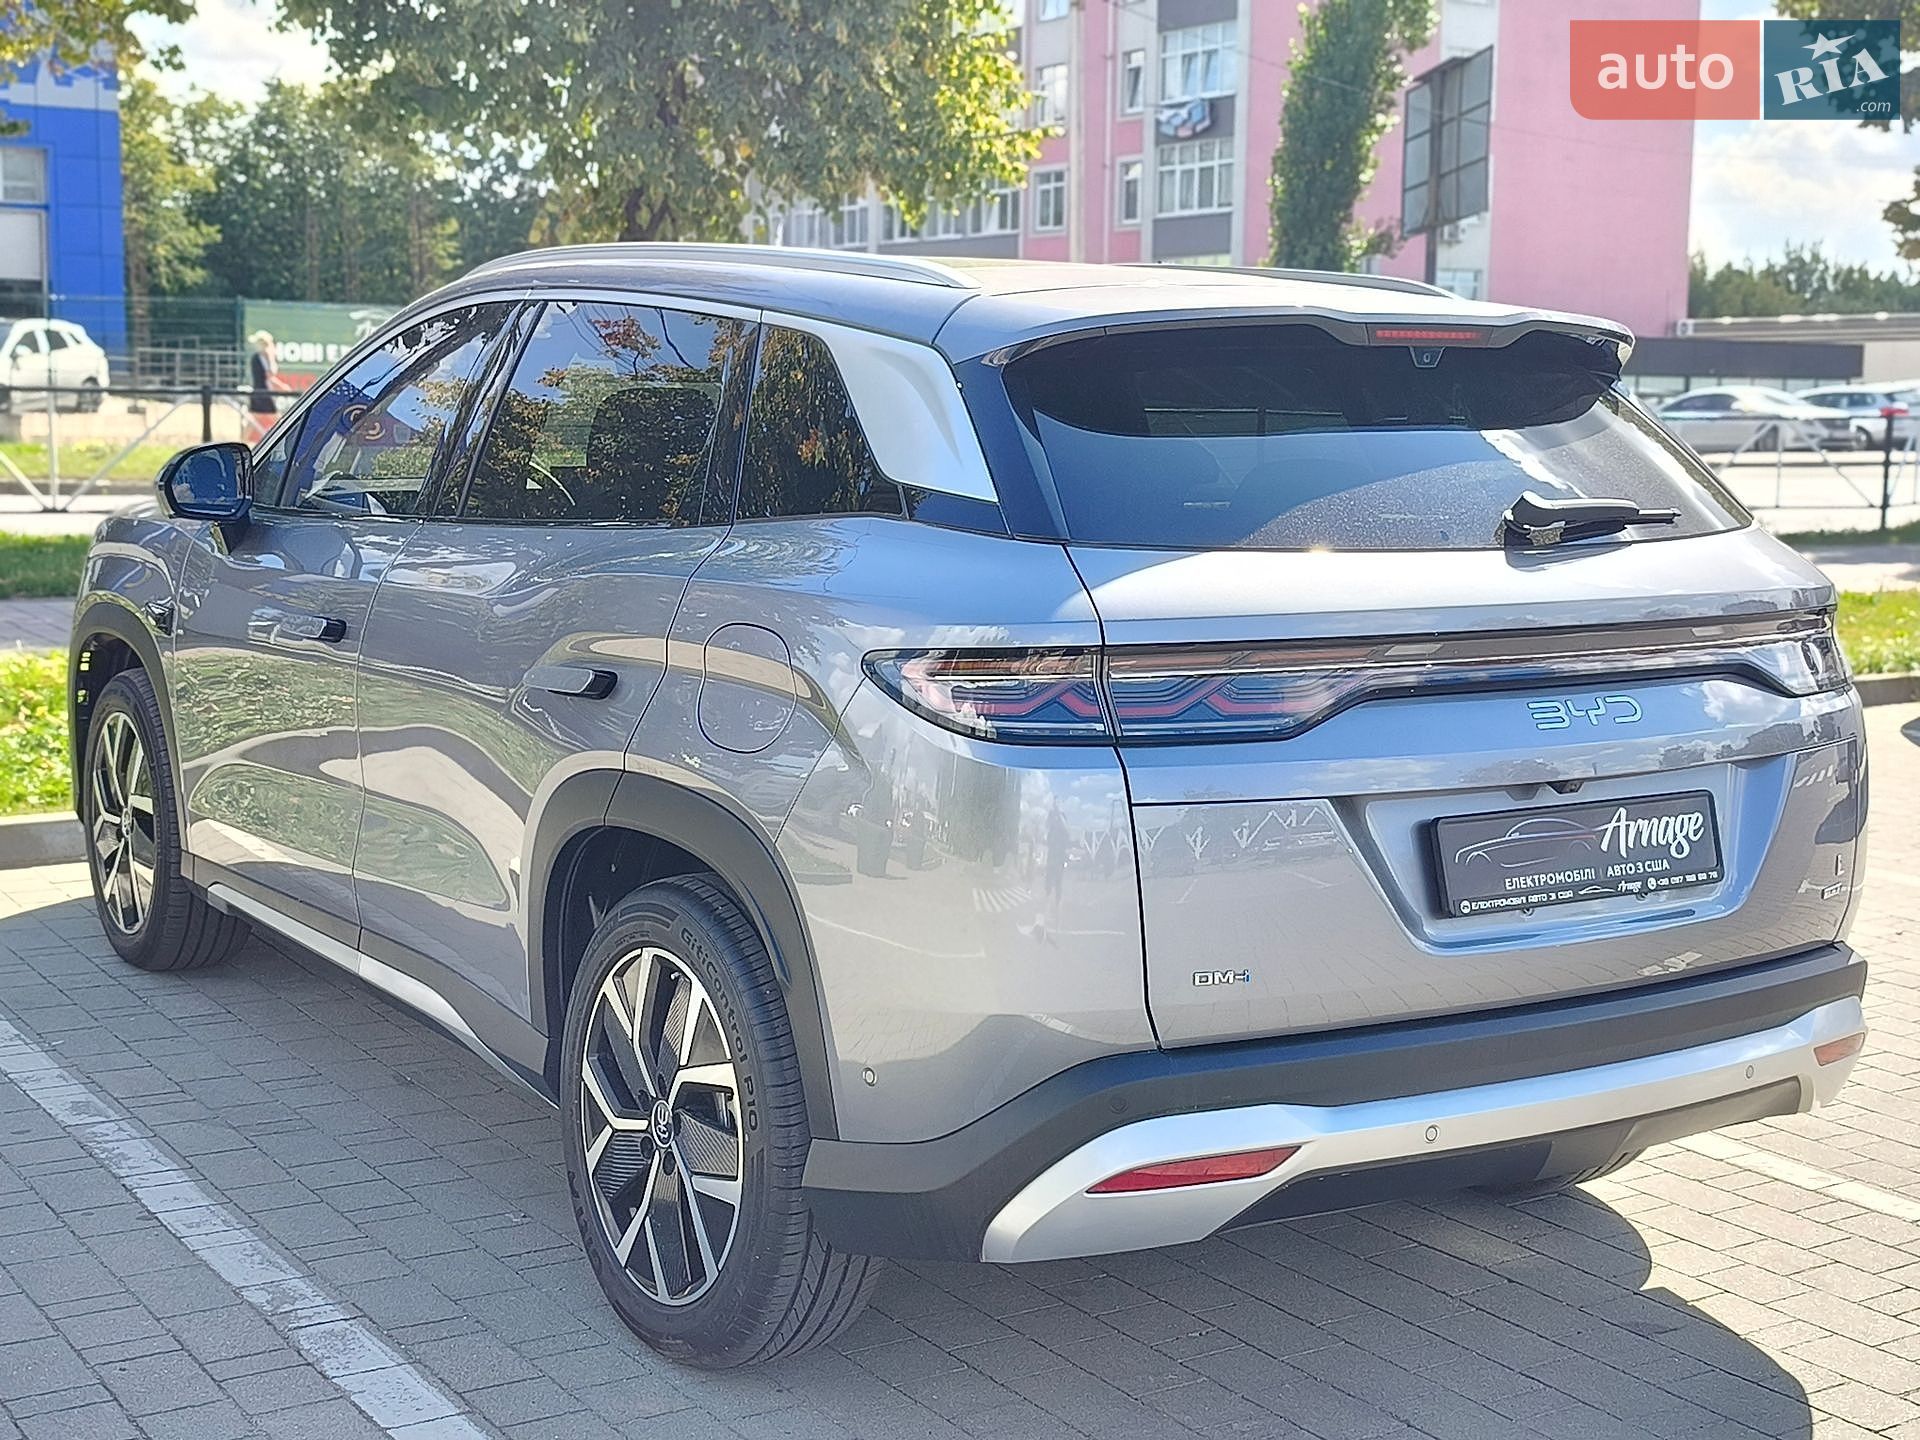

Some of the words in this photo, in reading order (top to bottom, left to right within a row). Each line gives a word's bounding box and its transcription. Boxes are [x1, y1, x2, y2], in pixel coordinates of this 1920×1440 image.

[1527, 695, 1643, 730] BYD
[1600, 807, 1704, 859] Arnage
[1505, 868, 1596, 890] ЕЛЕКТРОМОБІЛІ
[1607, 863, 1635, 877] АВТО
[1645, 859, 1670, 872] США
[680, 927, 749, 1064] GitiControl
